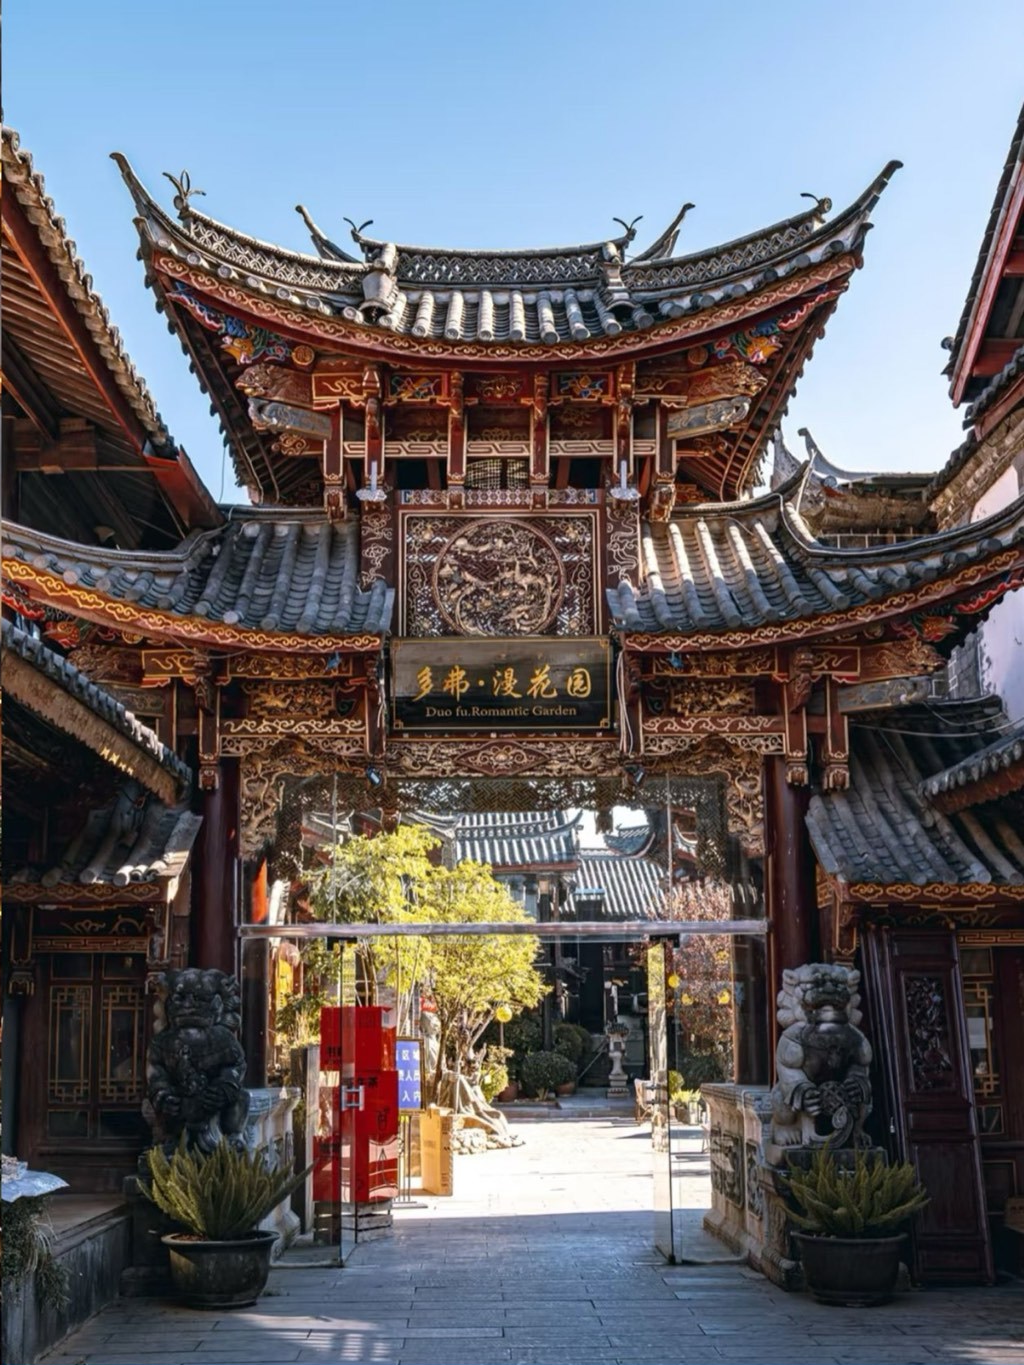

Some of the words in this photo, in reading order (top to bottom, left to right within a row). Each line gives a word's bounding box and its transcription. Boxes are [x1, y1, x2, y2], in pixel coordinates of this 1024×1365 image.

[412, 664, 592, 702] 多弗·漫花园
[426, 706, 453, 717] Duo
[532, 705, 577, 717] Garden
